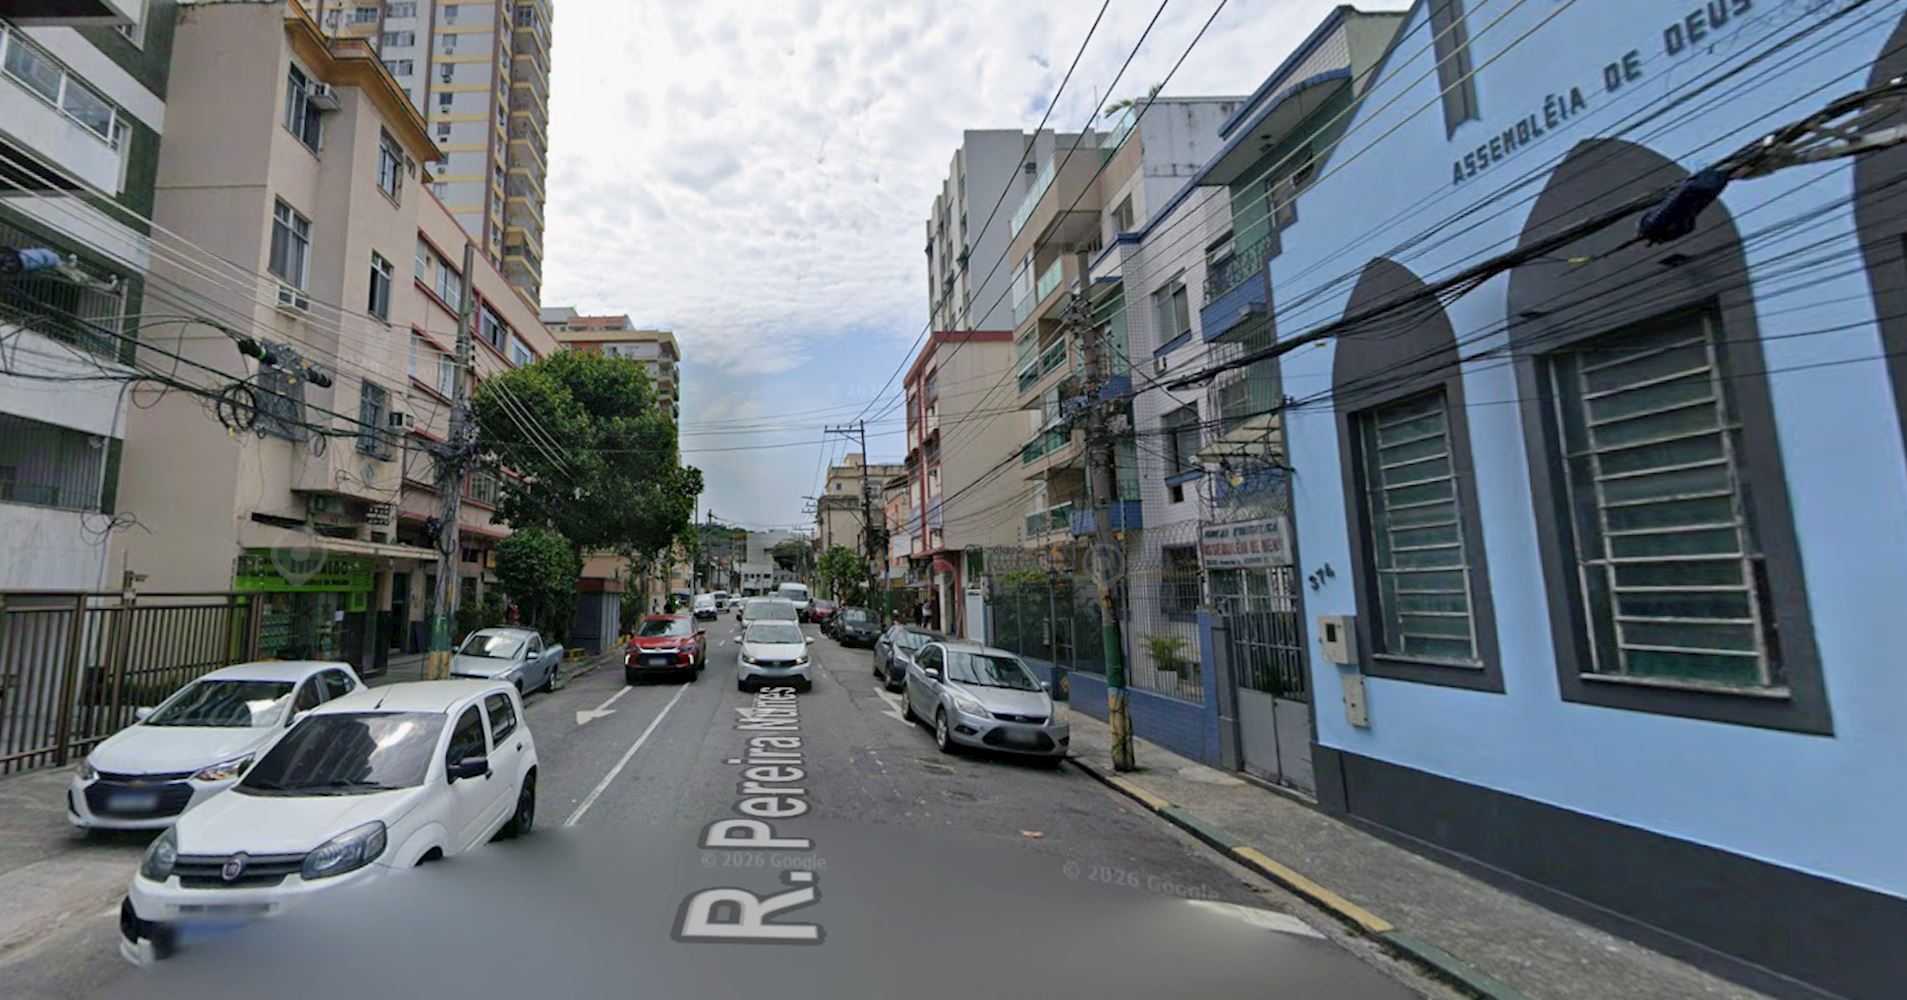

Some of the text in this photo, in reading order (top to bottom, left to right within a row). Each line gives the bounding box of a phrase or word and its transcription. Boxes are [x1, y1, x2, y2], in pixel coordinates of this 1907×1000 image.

[1453, 0, 1753, 185] ASSEMBLÉIA DE DEUS
[1308, 562, 1336, 591] 374
